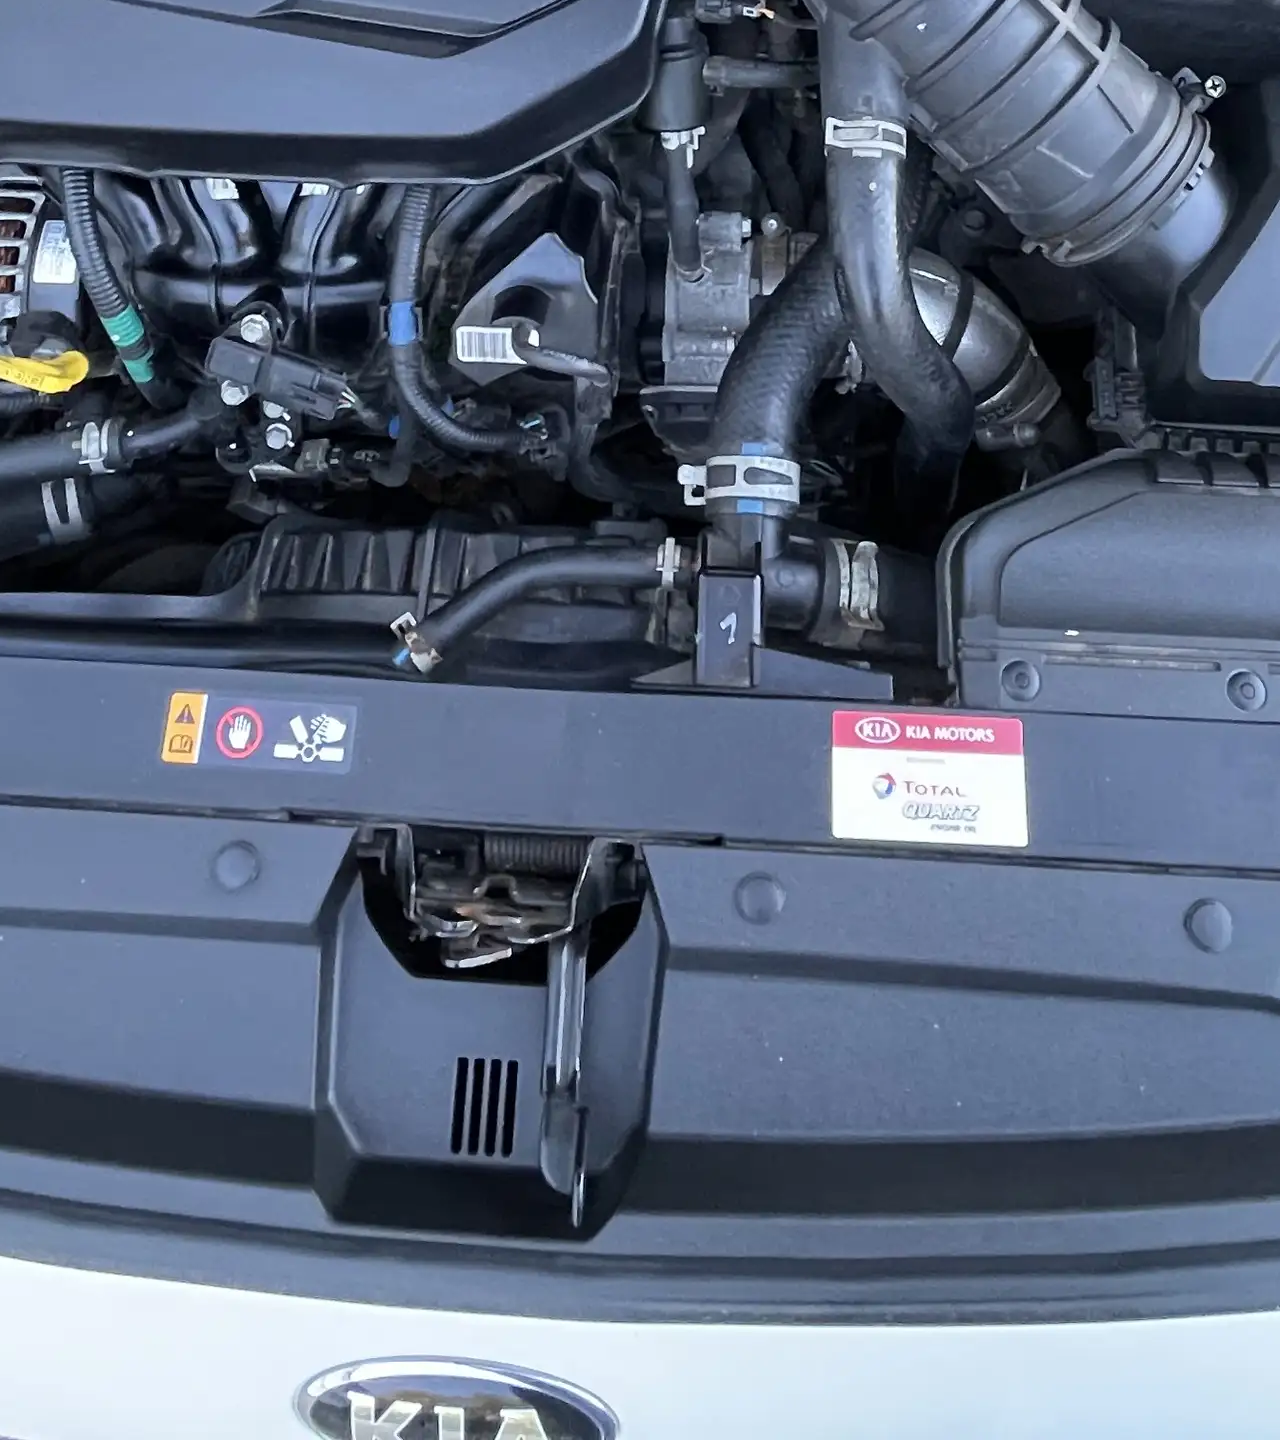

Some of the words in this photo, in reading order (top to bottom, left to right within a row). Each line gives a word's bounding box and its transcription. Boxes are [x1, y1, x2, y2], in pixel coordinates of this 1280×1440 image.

[863, 722, 893, 738] KIA
[905, 725, 931, 740] KIA
[934, 726, 996, 743] MOTORS
[903, 780, 967, 798] TOTAL
[902, 800, 980, 822] QUARTZ
[347, 1391, 549, 1440] KIA
